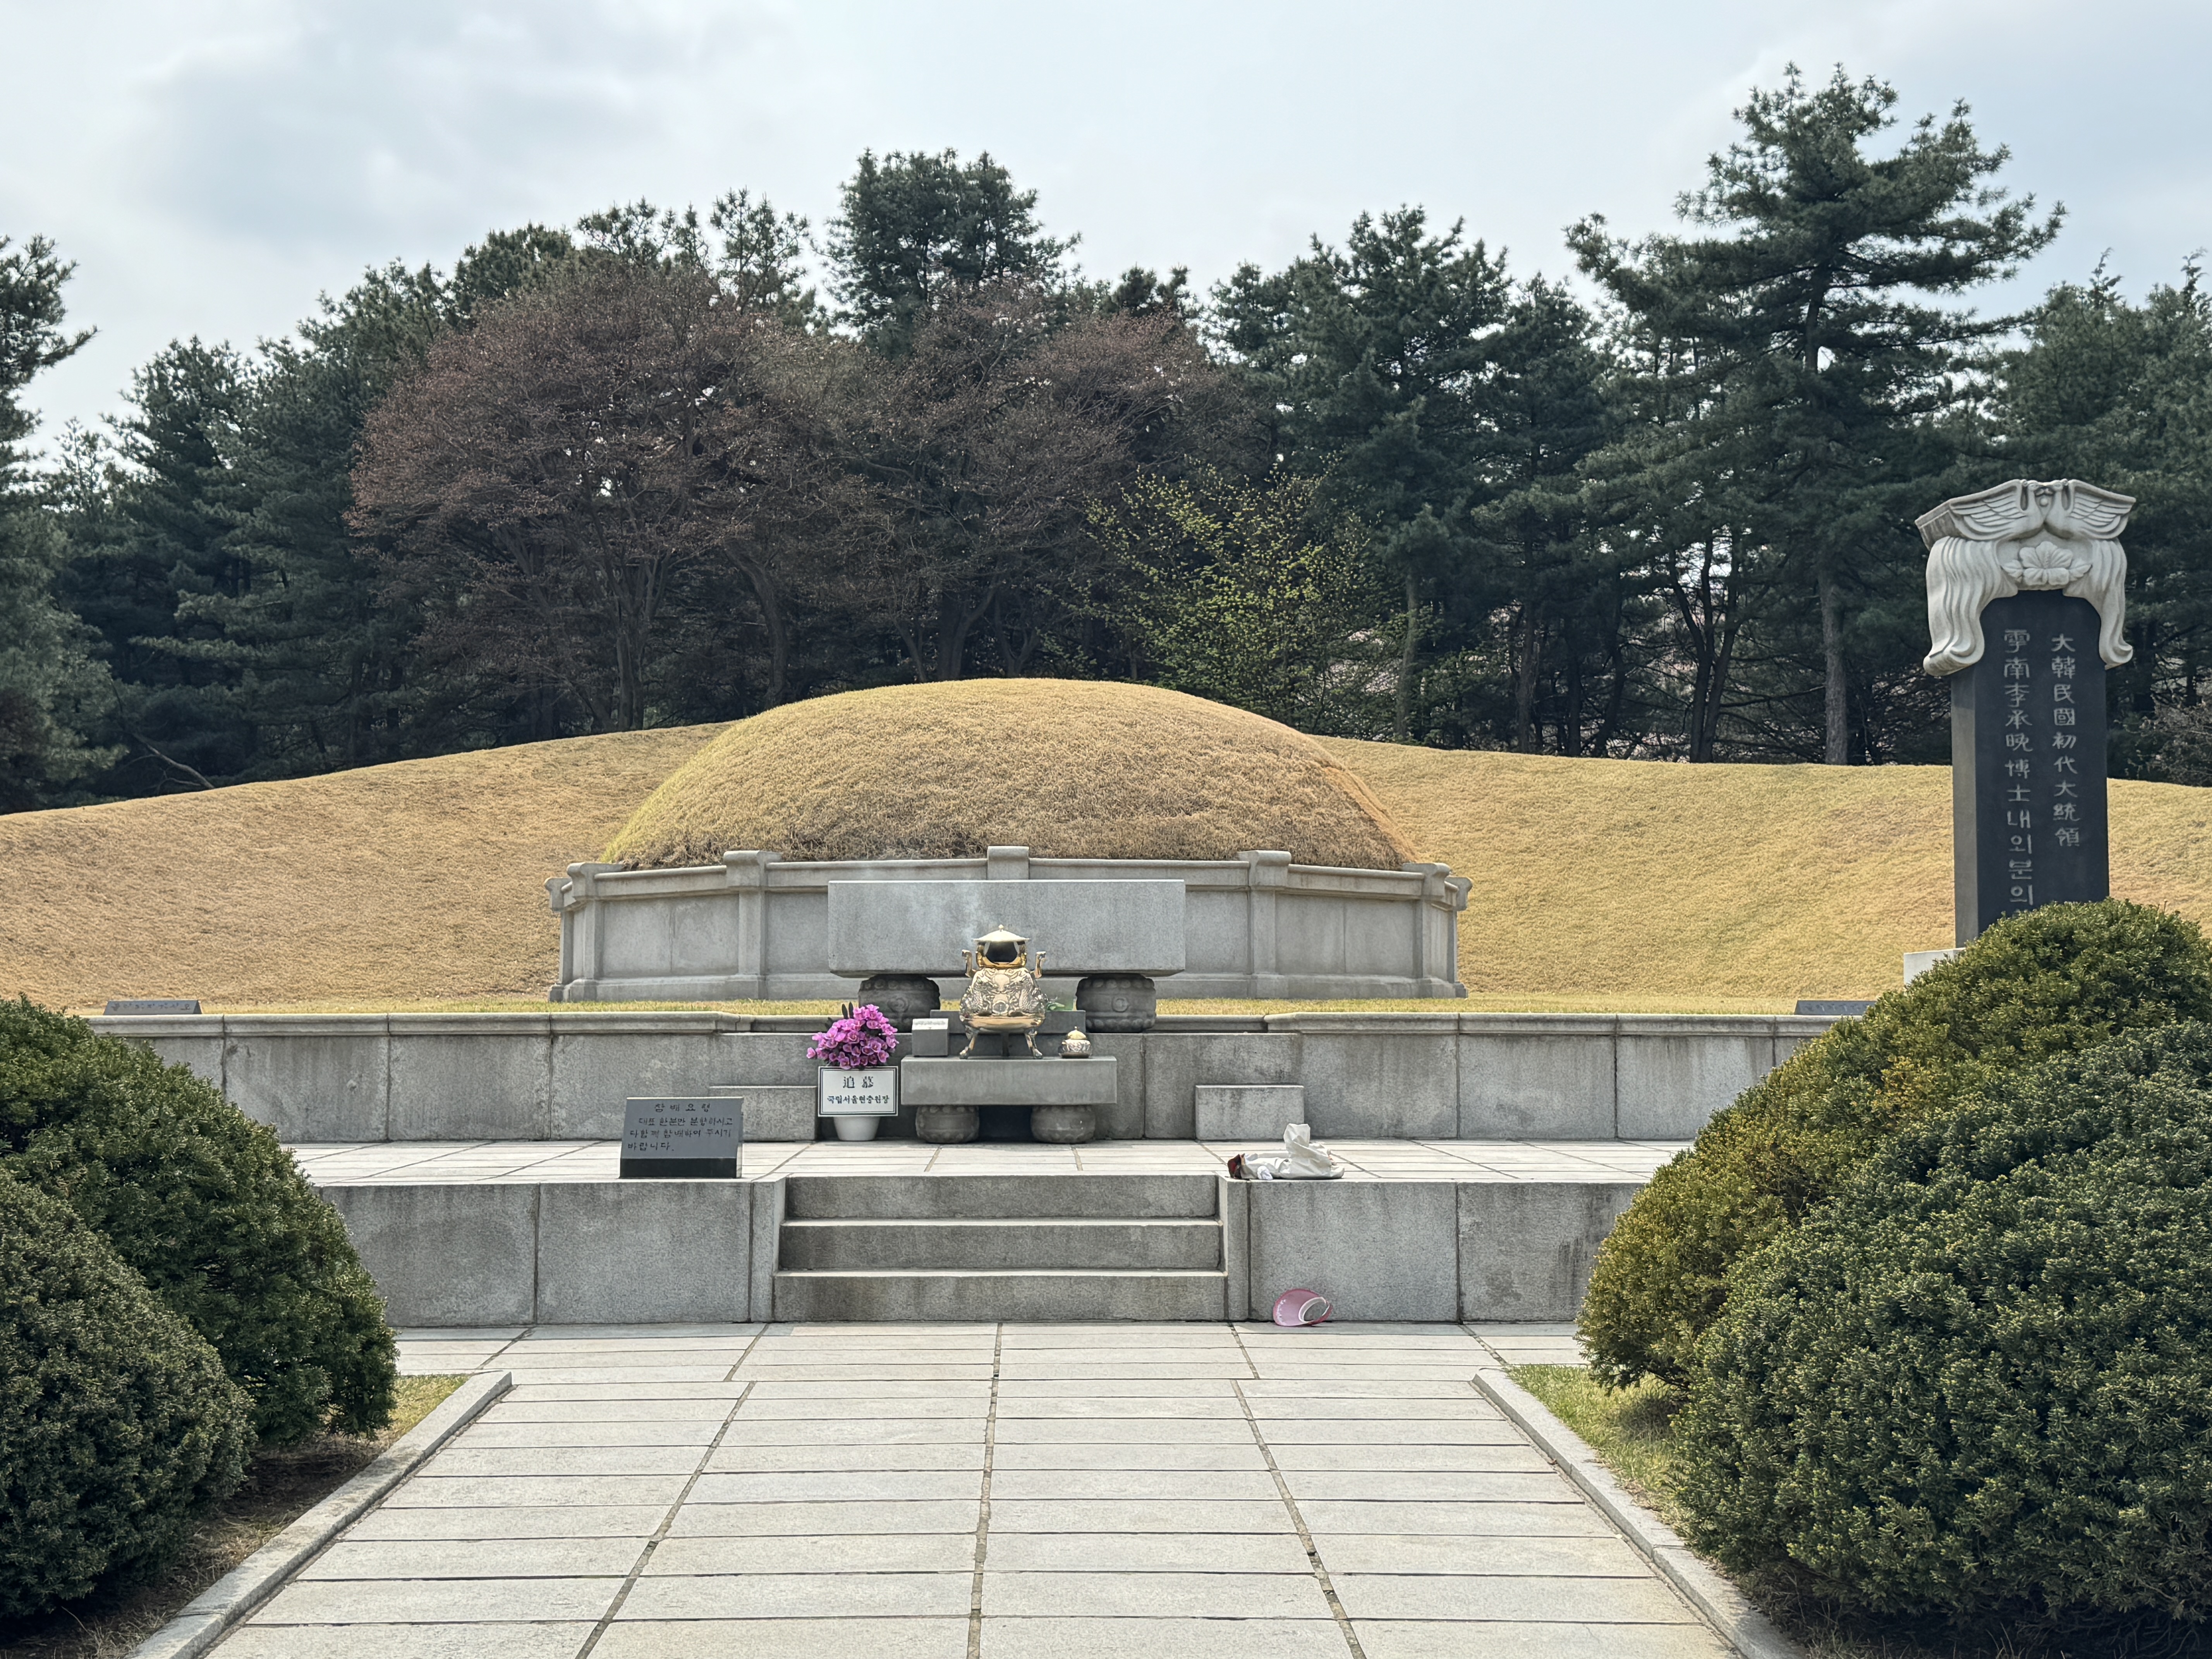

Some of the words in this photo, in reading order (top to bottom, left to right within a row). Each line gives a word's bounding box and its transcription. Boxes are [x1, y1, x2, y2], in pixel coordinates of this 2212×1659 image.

[2052, 634, 2080, 847] 大韓民國初代大統領
[827, 1095, 890, 1104] 국립서울현충원장
[690, 1117, 733, 1126] 분향하시고
[705, 1129, 730, 1137] 주시기
